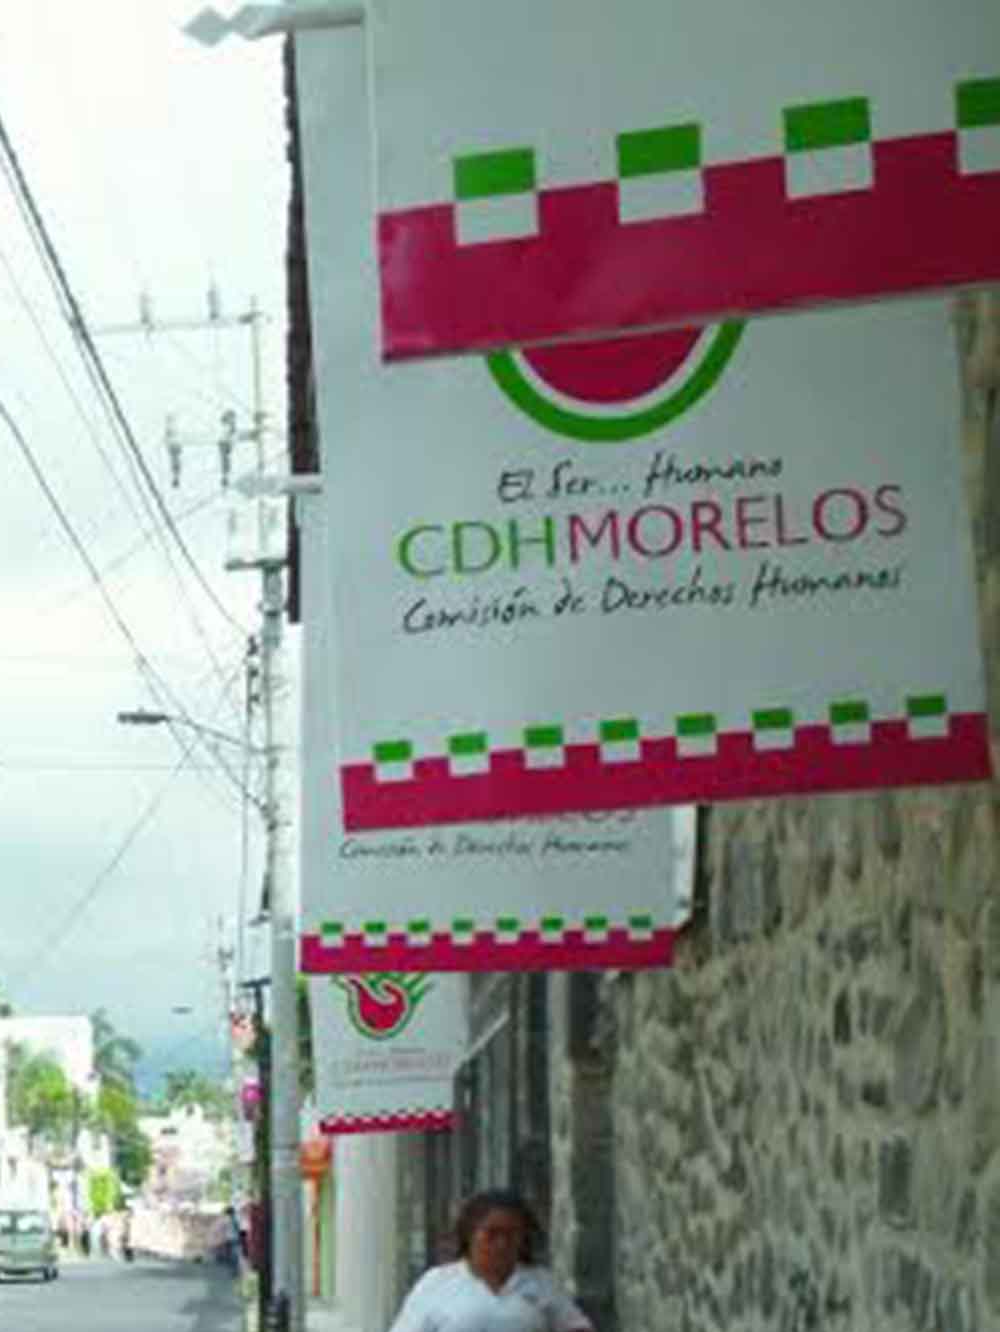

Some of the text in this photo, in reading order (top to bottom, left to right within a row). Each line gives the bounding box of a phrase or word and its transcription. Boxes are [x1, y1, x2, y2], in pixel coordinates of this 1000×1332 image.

[498, 468, 534, 503] El
[643, 450, 782, 499] Humano
[397, 484, 908, 579] CDHMORELOS
[402, 560, 903, 635] Comisión de Derechos Humanos
